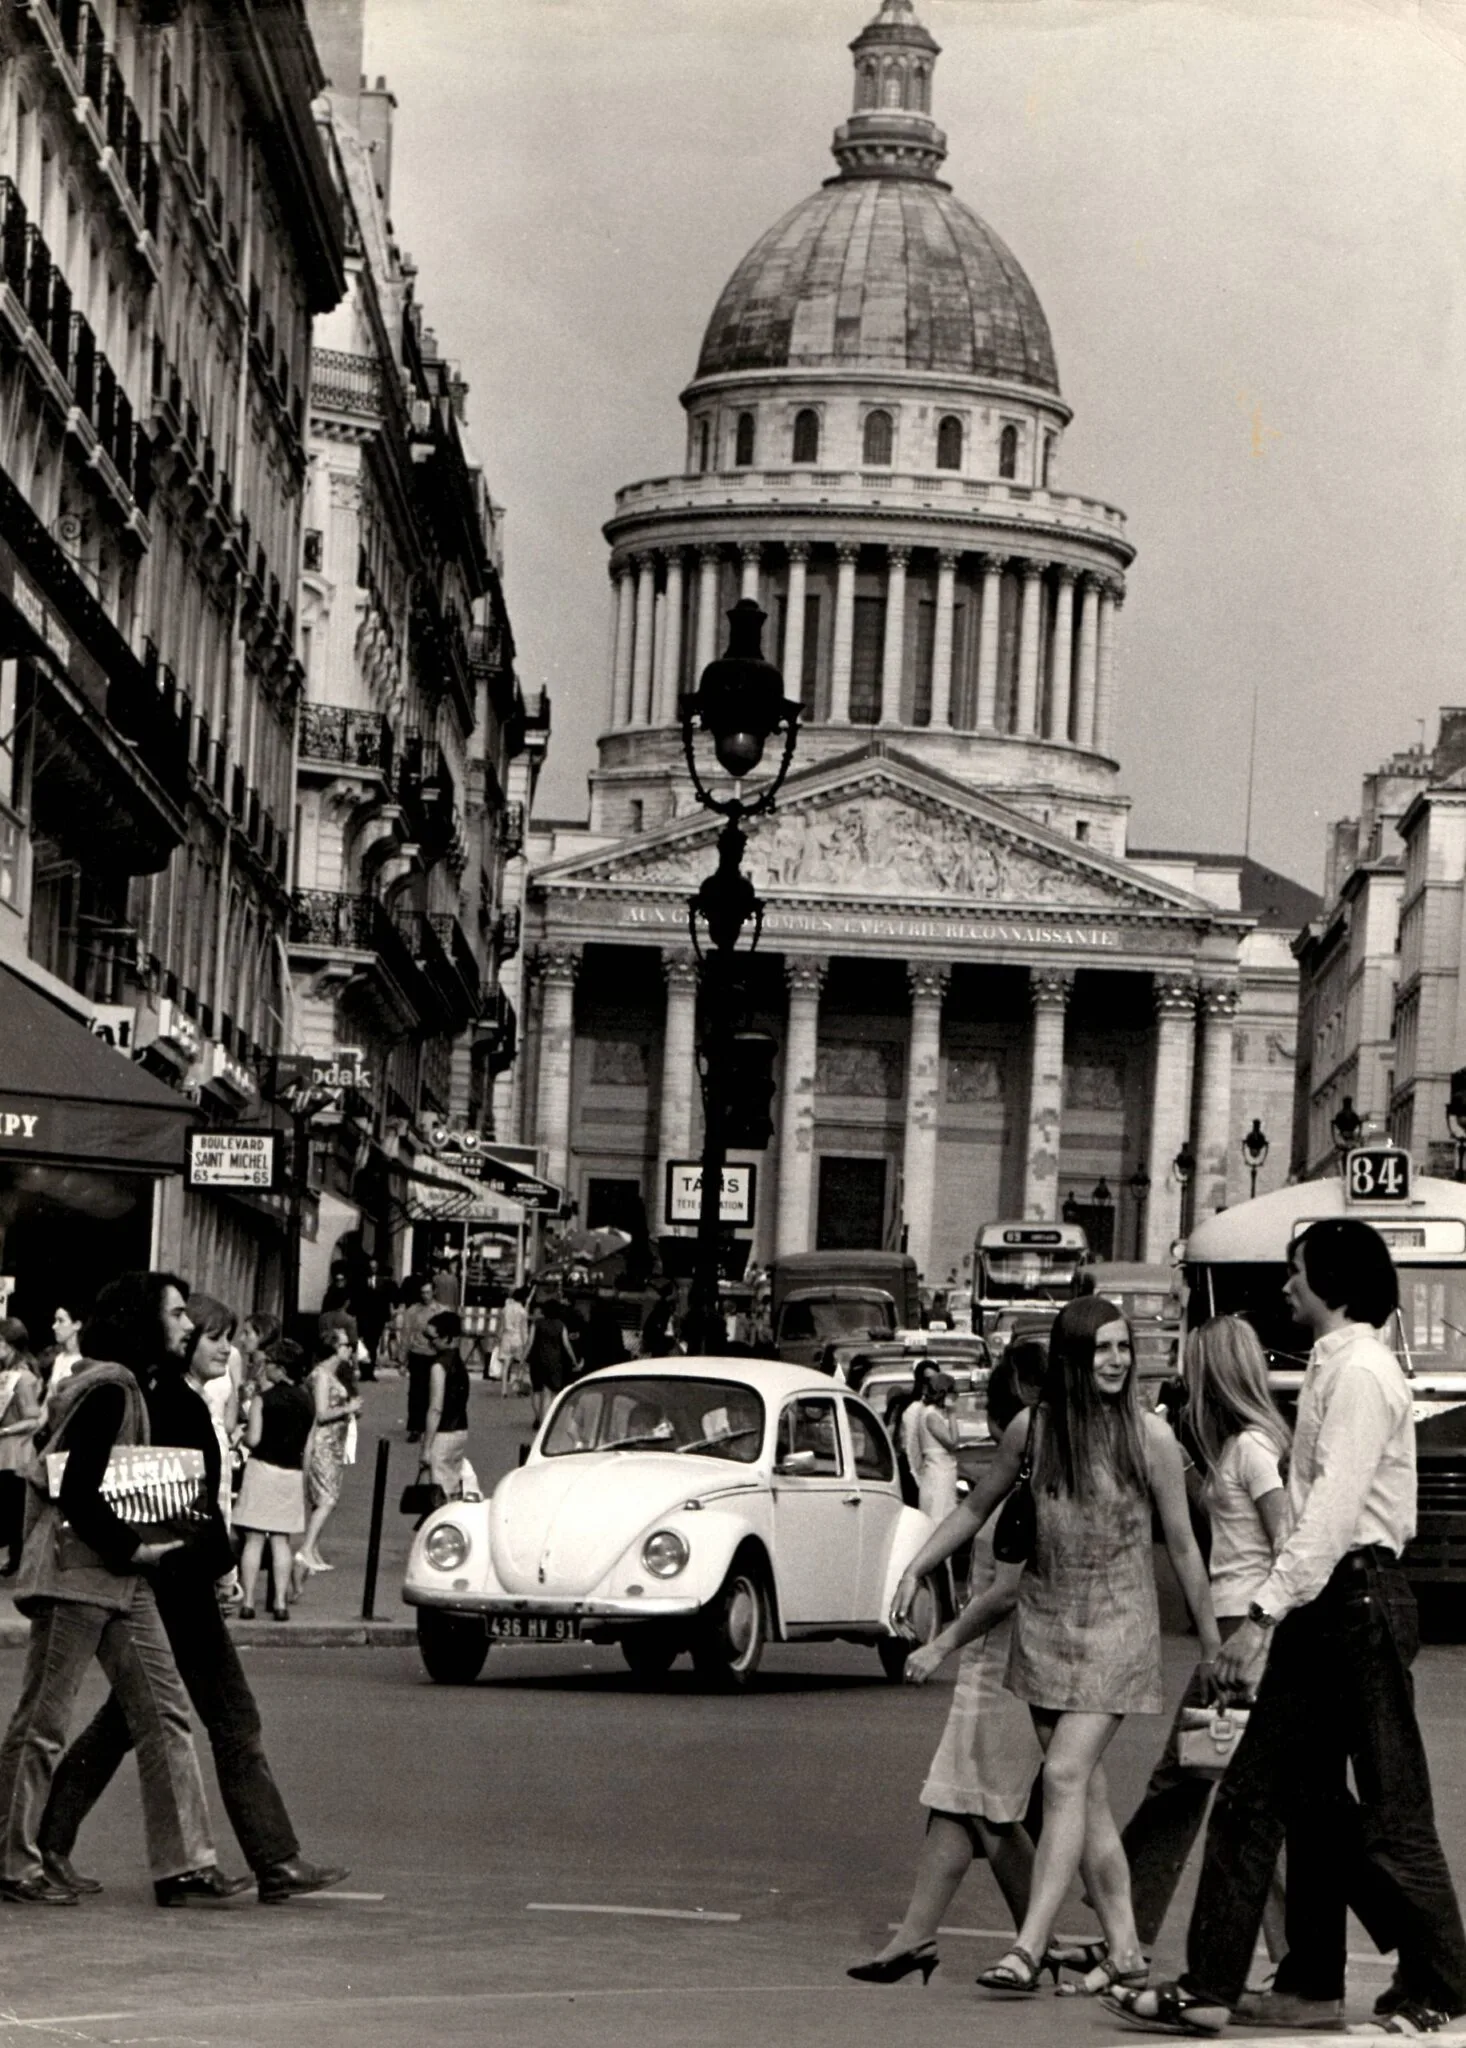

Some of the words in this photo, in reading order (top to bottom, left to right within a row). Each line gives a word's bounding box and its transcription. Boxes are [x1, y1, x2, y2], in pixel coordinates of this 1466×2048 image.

[873, 920, 941, 937] PATRIE
[946, 922, 1114, 946] RECONNAISSANTE
[311, 1061, 372, 1089] odak
[0, 1112, 39, 1138] PY
[200, 1137, 265, 1151] BOULEVARD
[194, 1152, 224, 1168] SAINT
[229, 1153, 269, 1170] MICHEL
[253, 1171, 269, 1184] 65
[681, 1177, 740, 1194] TAIS
[1352, 1156, 1404, 1194] 84
[491, 1617, 522, 1637] 436
[528, 1618, 548, 1637] HV
[556, 1619, 575, 1639] 91
